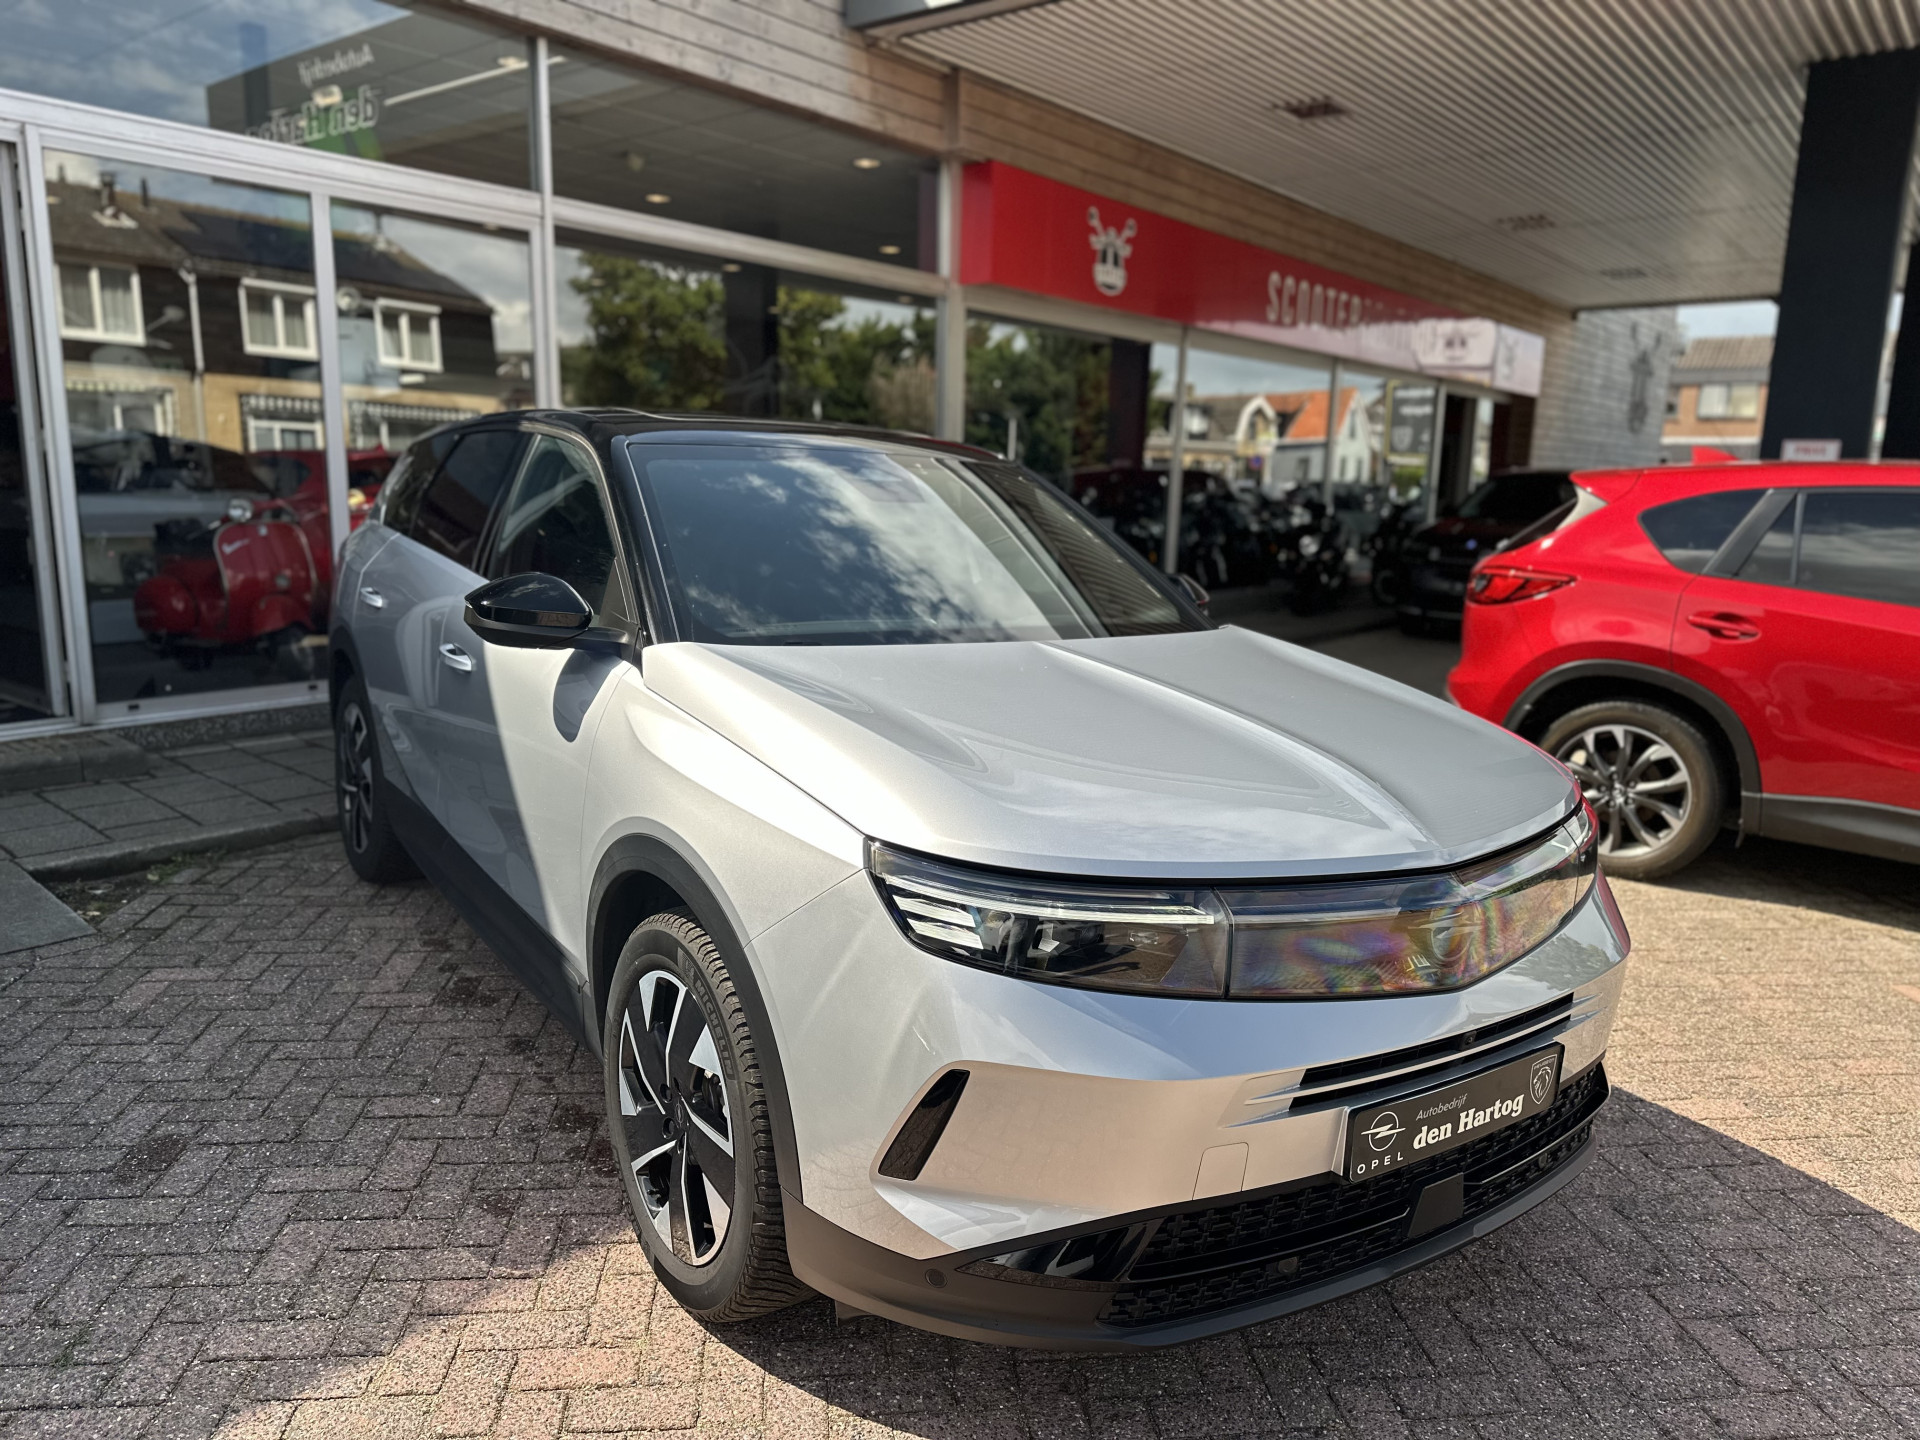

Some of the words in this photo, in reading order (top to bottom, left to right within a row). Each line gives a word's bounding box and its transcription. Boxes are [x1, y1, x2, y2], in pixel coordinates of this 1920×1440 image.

[694, 979, 735, 1077] MICHELIN
[1412, 1122, 1452, 1150] den
[1457, 1094, 1525, 1134] Hartog
[1415, 1093, 1468, 1121] Autobedrijf
[1356, 1151, 1404, 1175] OPEL
